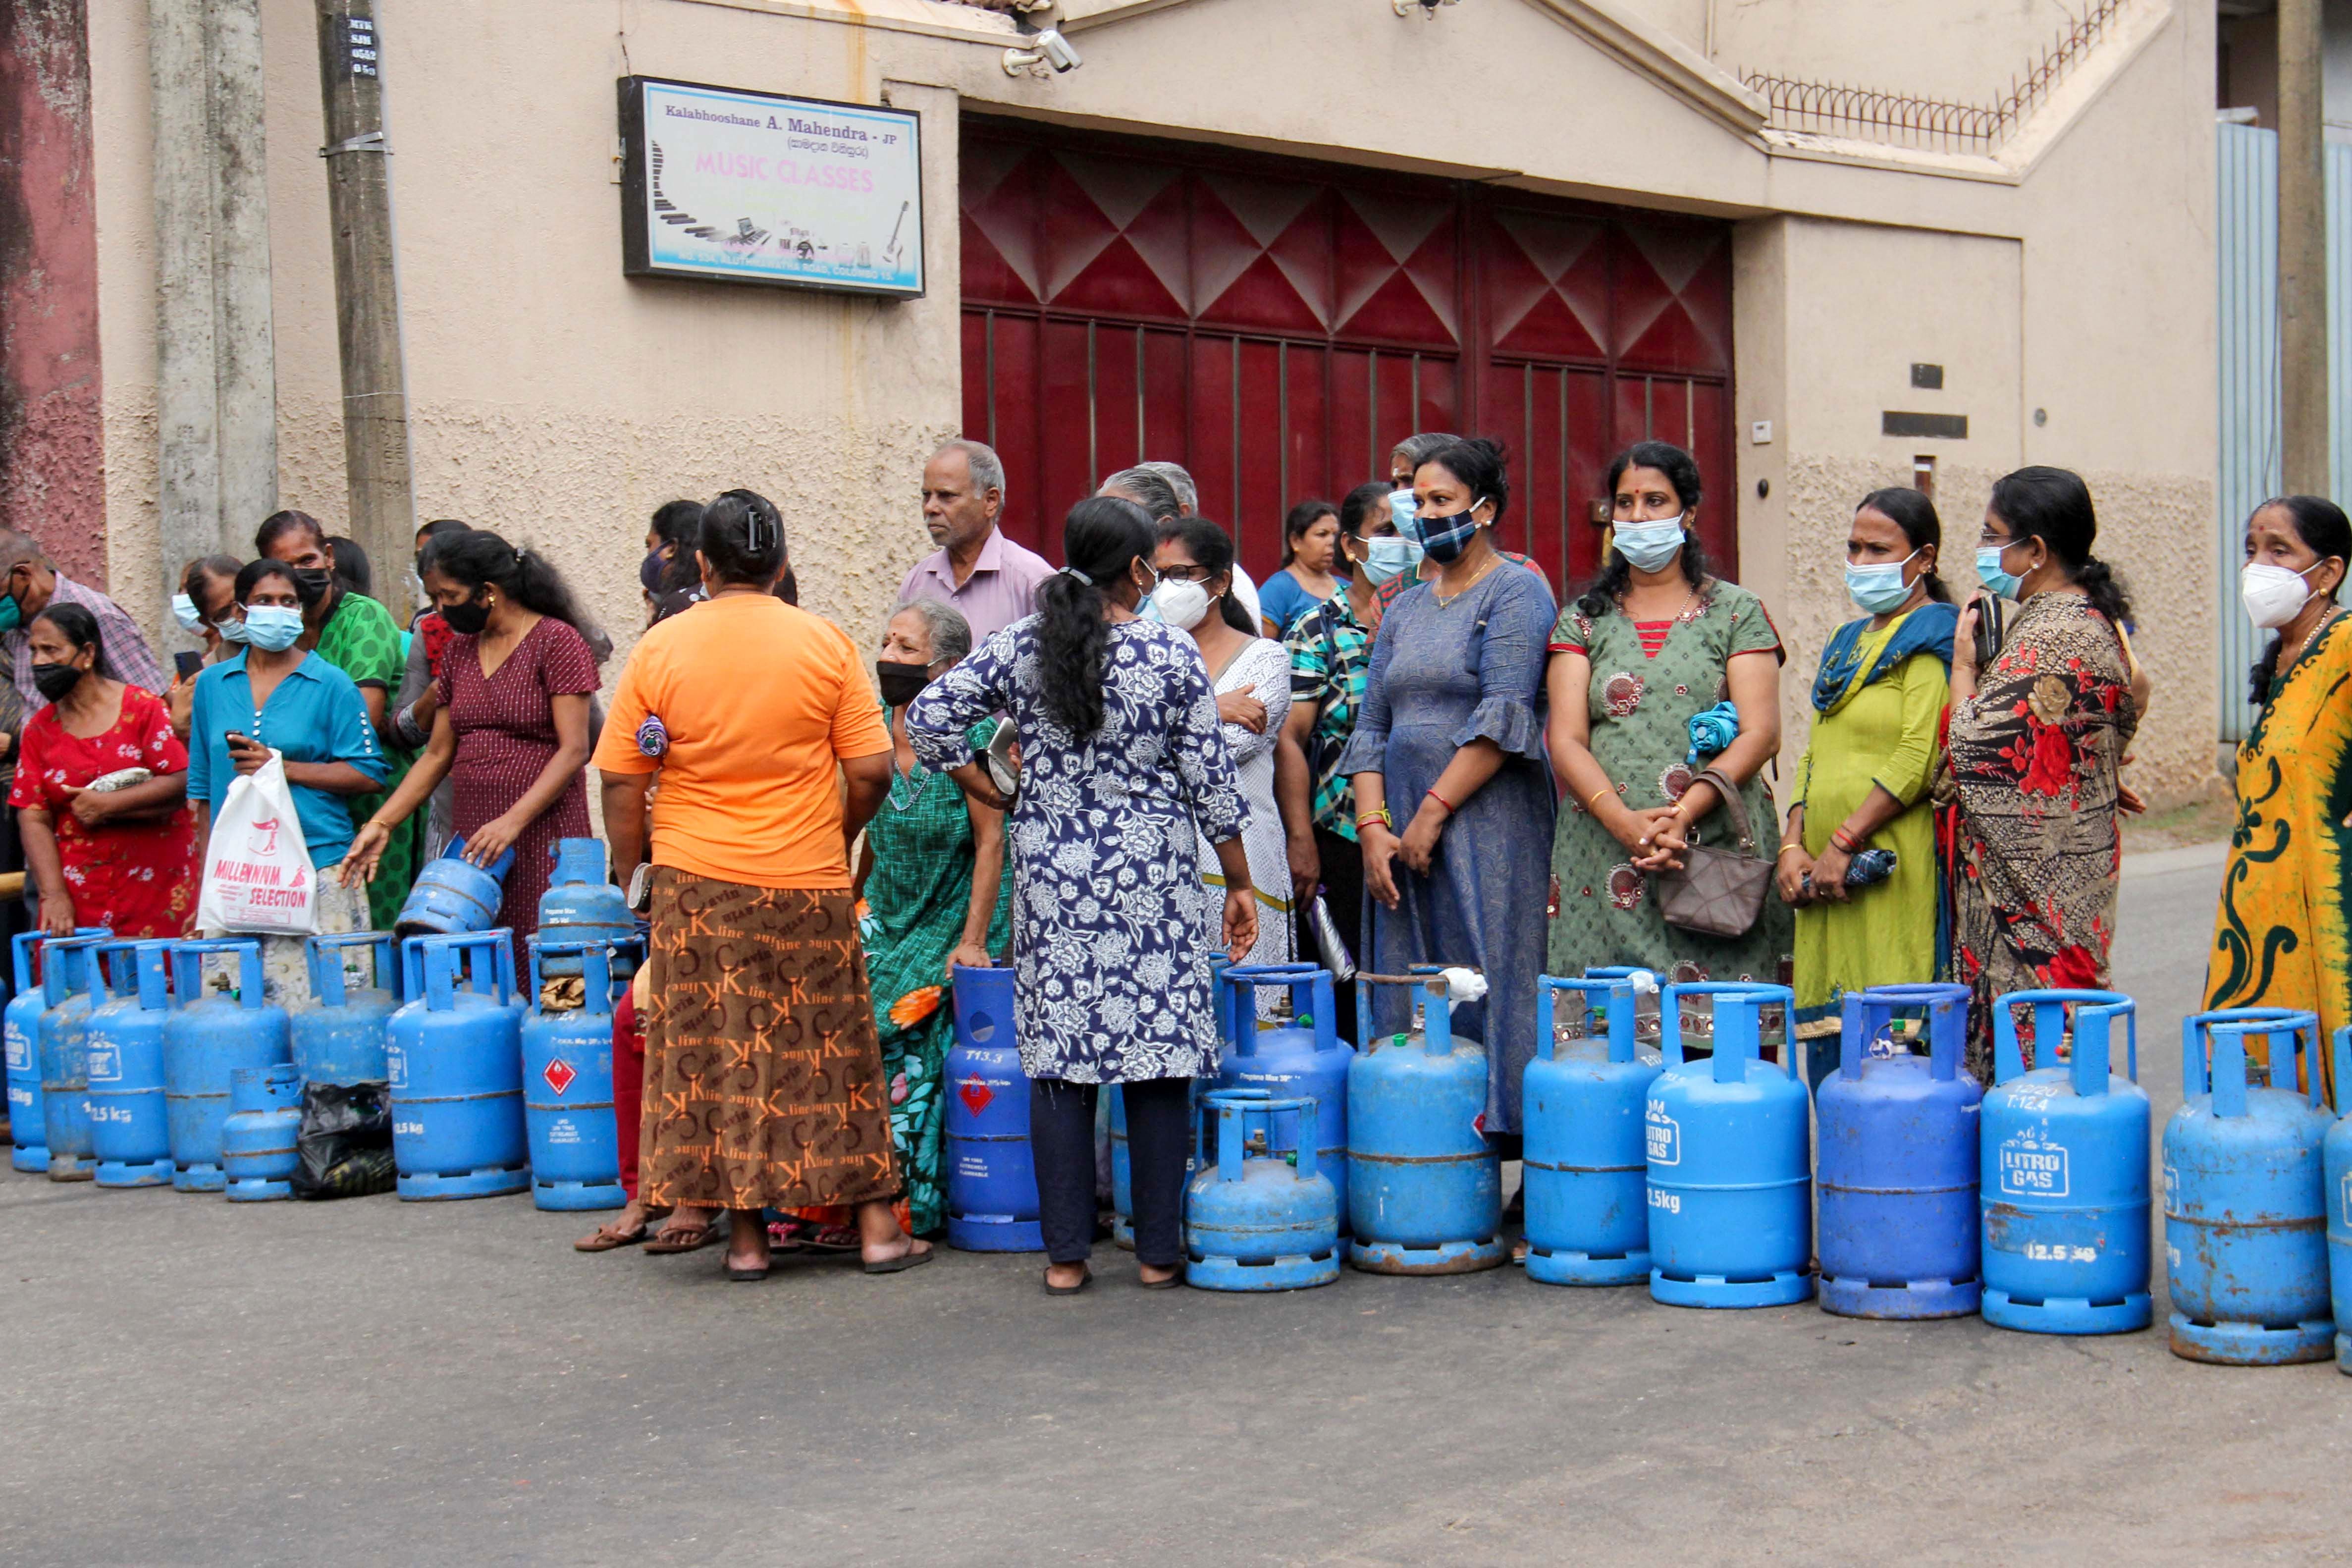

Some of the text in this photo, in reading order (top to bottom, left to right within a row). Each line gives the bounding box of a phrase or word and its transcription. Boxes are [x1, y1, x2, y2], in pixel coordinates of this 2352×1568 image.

[665, 105, 760, 128] Kalabhooshane
[766, 115, 782, 130] A.
[787, 118, 867, 142] Mahendra
[882, 134, 897, 145] JP
[695, 151, 874, 193] MUSIC CLASSES
[832, 267, 878, 279] COLOMBO
[249, 887, 307, 908] SELECTION
[966, 1050, 1003, 1064] T13.3
[1648, 1140, 1667, 1158] GAS
[2006, 1152, 2059, 1172] LITRO
[2012, 1170, 2053, 1188] GAS
